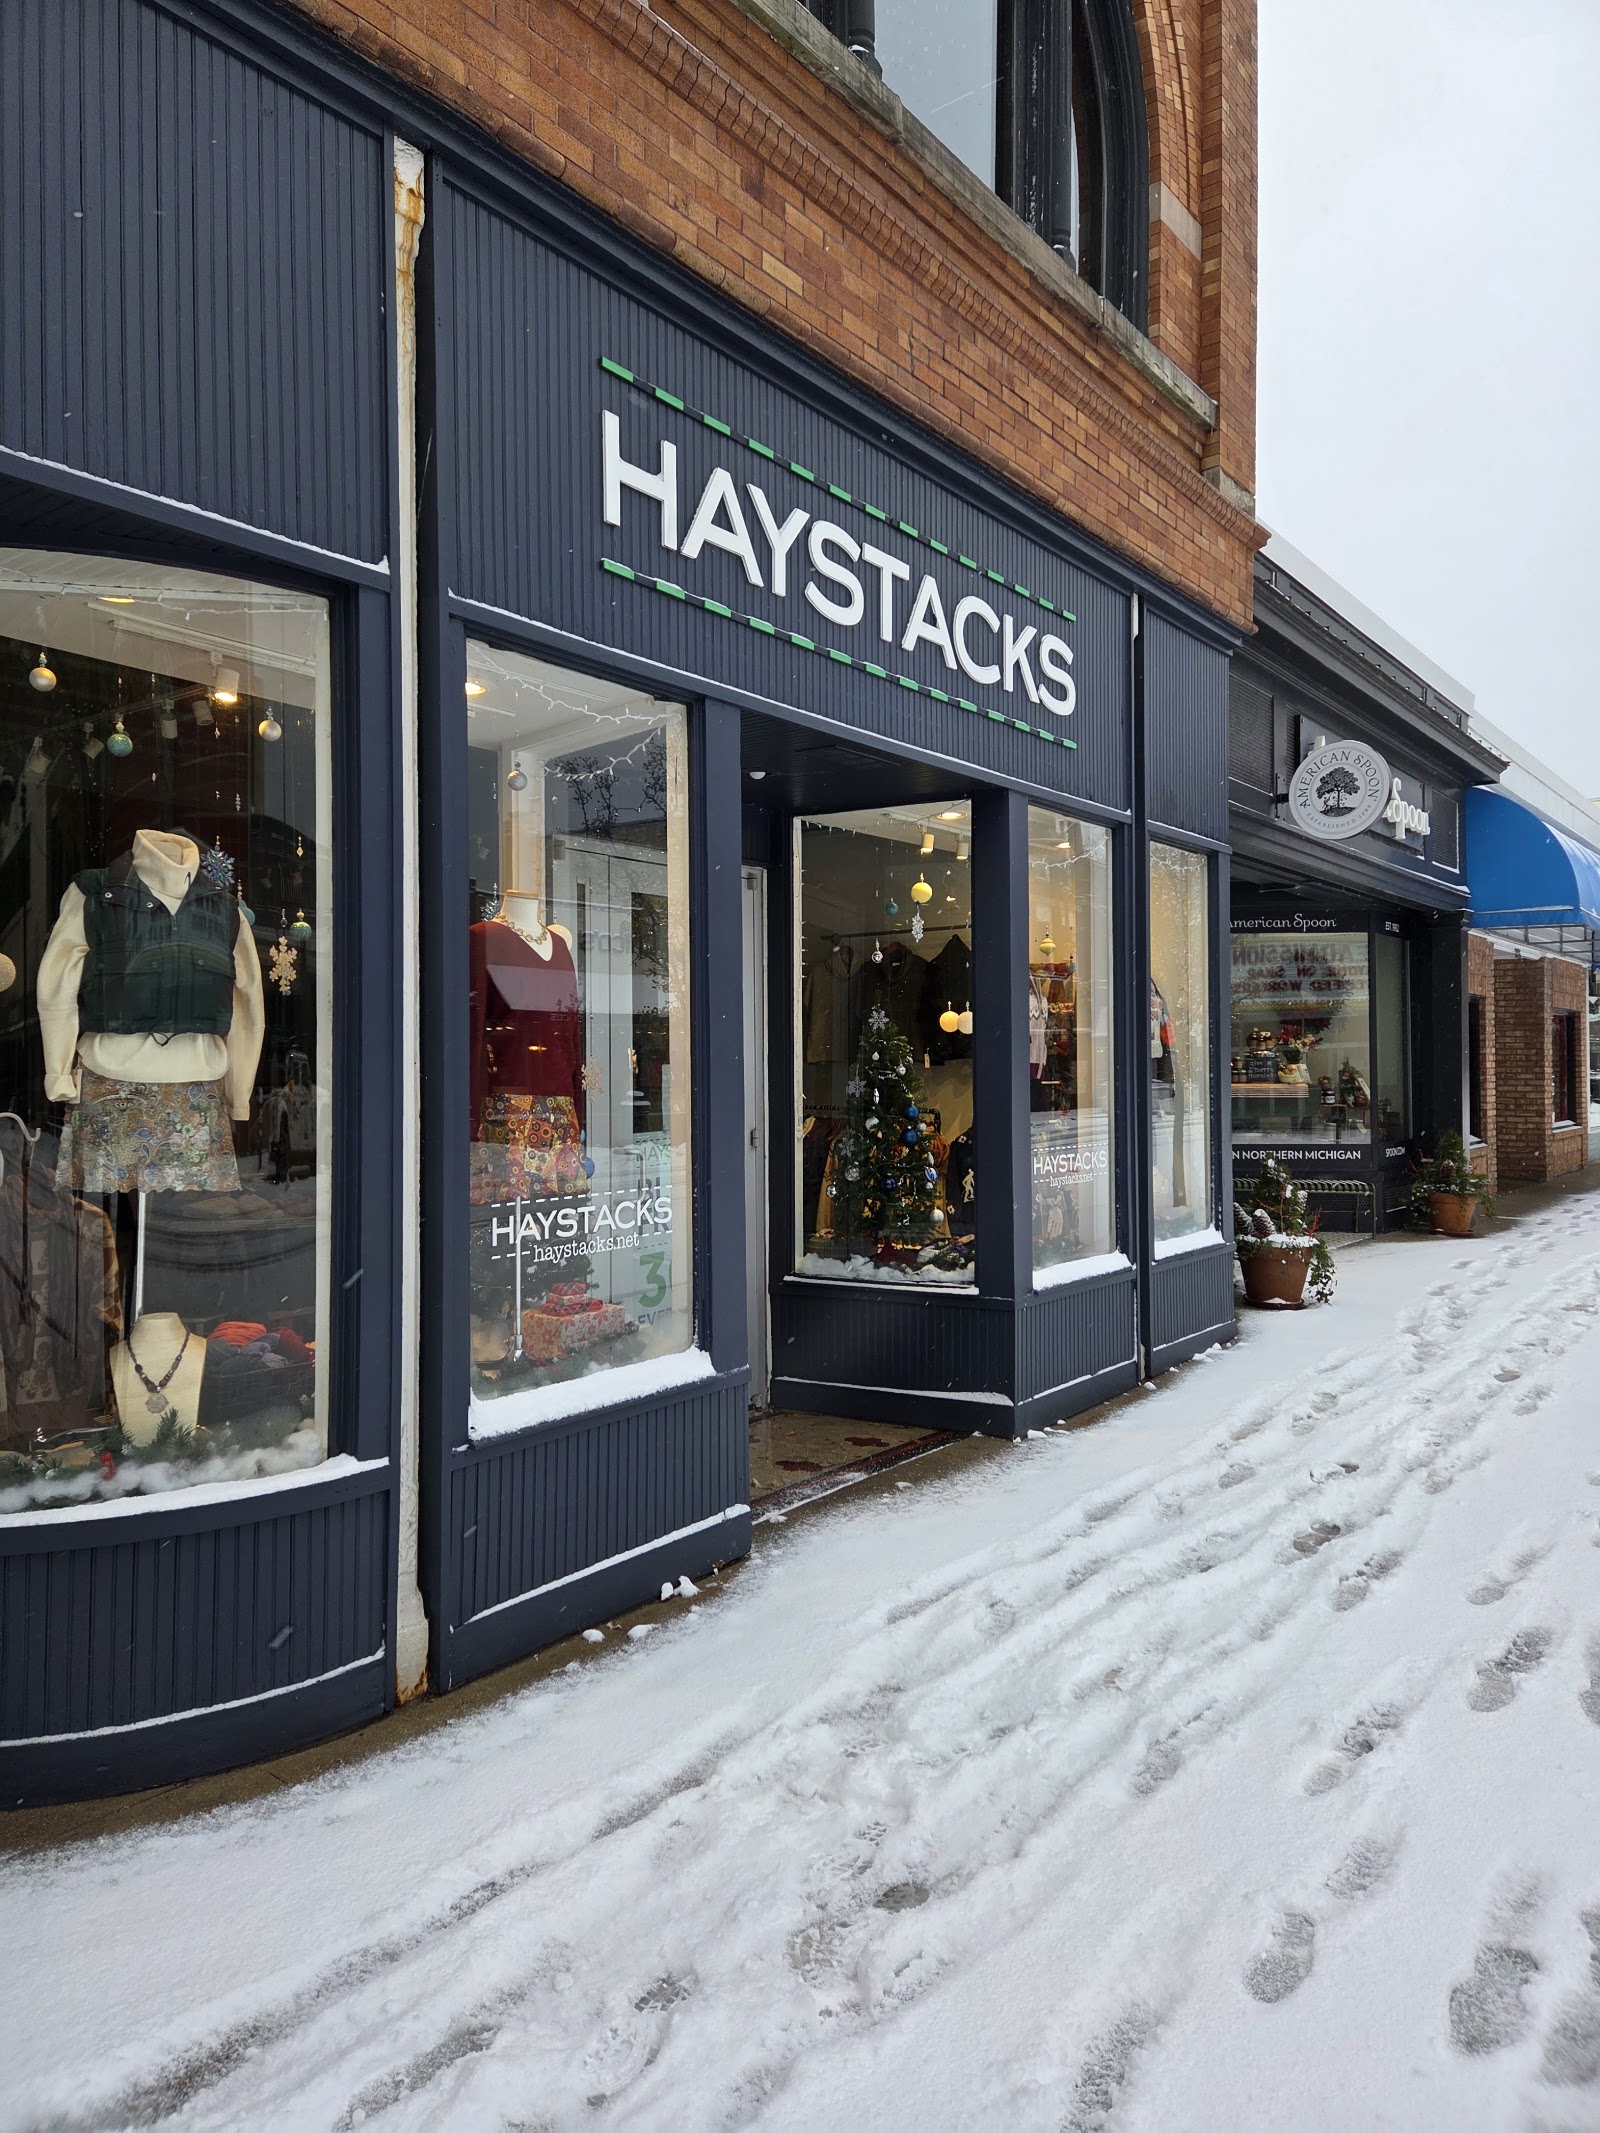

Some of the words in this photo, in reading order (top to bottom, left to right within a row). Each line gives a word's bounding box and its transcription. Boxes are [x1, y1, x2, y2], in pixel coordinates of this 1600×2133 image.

[602, 409, 1077, 716] HAYSTACKS
[1297, 750, 1352, 809] AMERICAN
[1353, 754, 1380, 800] SPOON
[1306, 812, 1357, 829] ESTABLISHED
[1293, 913, 1337, 932] Spoon
[1033, 1150, 1108, 1176] HAYSTACKS
[1304, 1150, 1361, 1160] MICHIGAN
[1050, 1172, 1094, 1188] haystacks.net
[492, 1197, 673, 1247] HAYSTACKS
[533, 1233, 641, 1263] haystacks.net
[639, 1250, 672, 1308] 3
